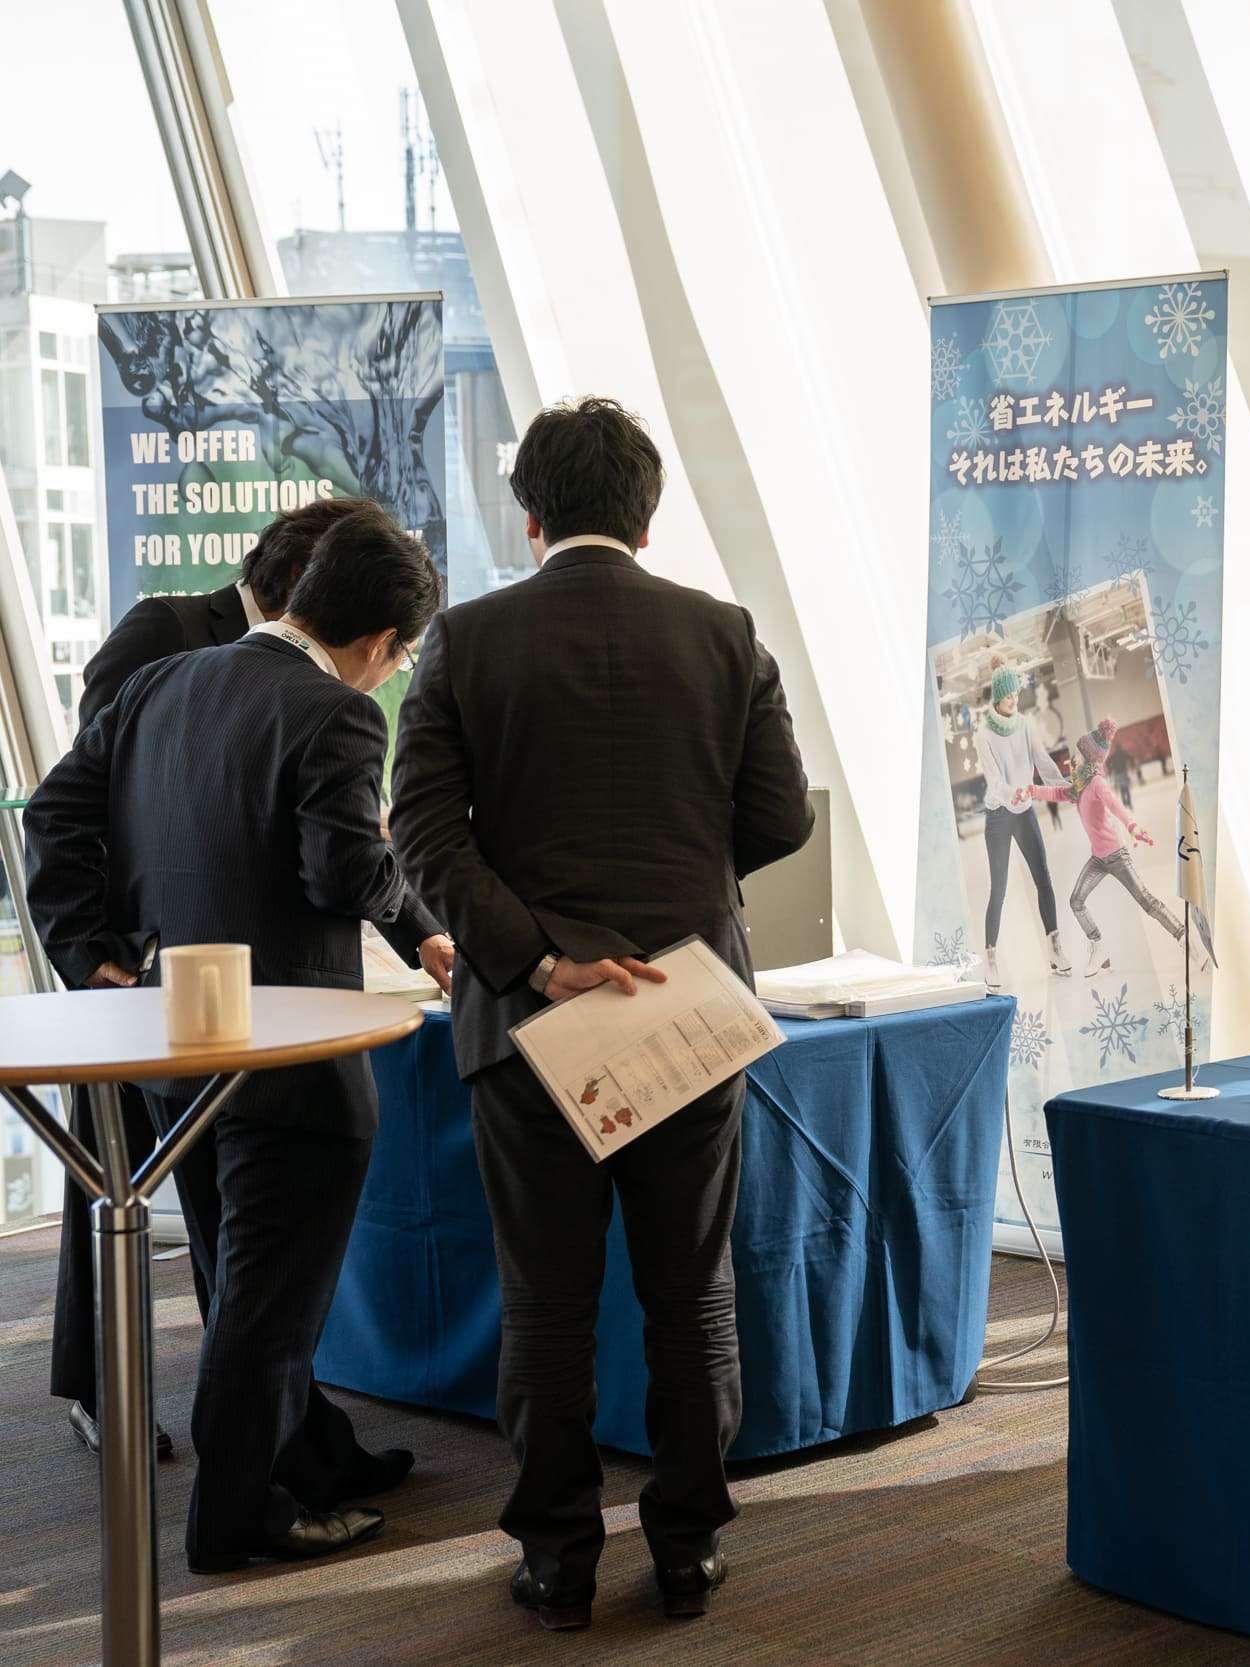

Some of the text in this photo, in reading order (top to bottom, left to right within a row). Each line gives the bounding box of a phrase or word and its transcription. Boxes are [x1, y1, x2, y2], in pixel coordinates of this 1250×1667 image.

[989, 386, 1153, 431] 省エネルギー
[130, 430, 256, 464] WE OFFER
[949, 439, 1208, 486] それは私たちの未来。
[132, 479, 333, 515] THE SOLUTIONS
[134, 535, 181, 566] FOR
